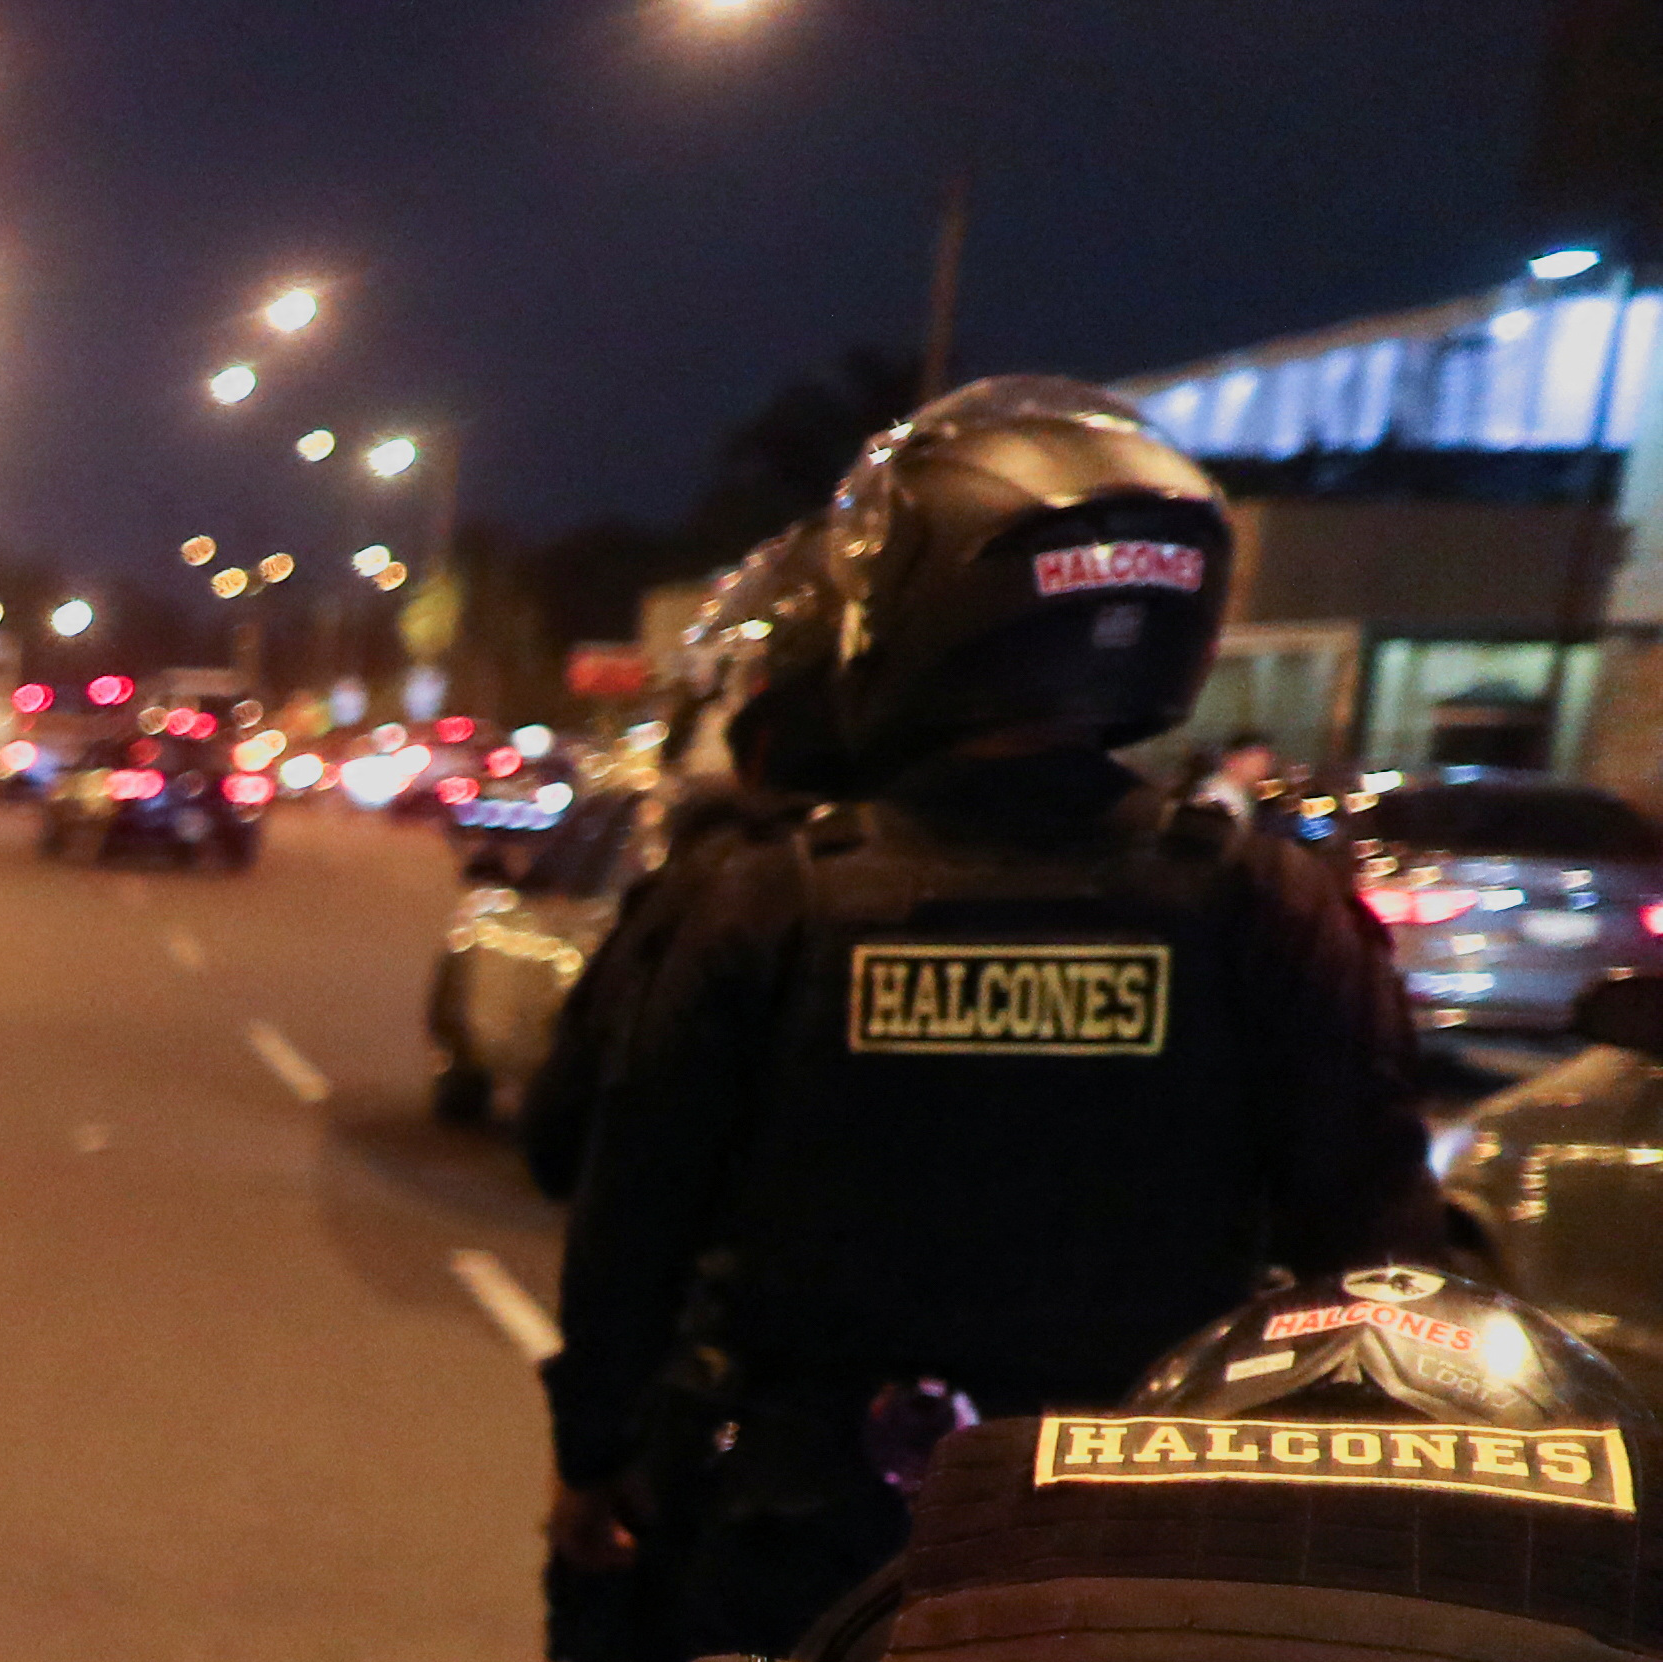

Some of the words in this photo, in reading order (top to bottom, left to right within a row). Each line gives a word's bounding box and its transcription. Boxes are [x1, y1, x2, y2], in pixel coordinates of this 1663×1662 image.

[868, 961, 1146, 1040] HALCONES
[1267, 1301, 1477, 1352] HALCONES
[1065, 1425, 1593, 1486] HALCONES
